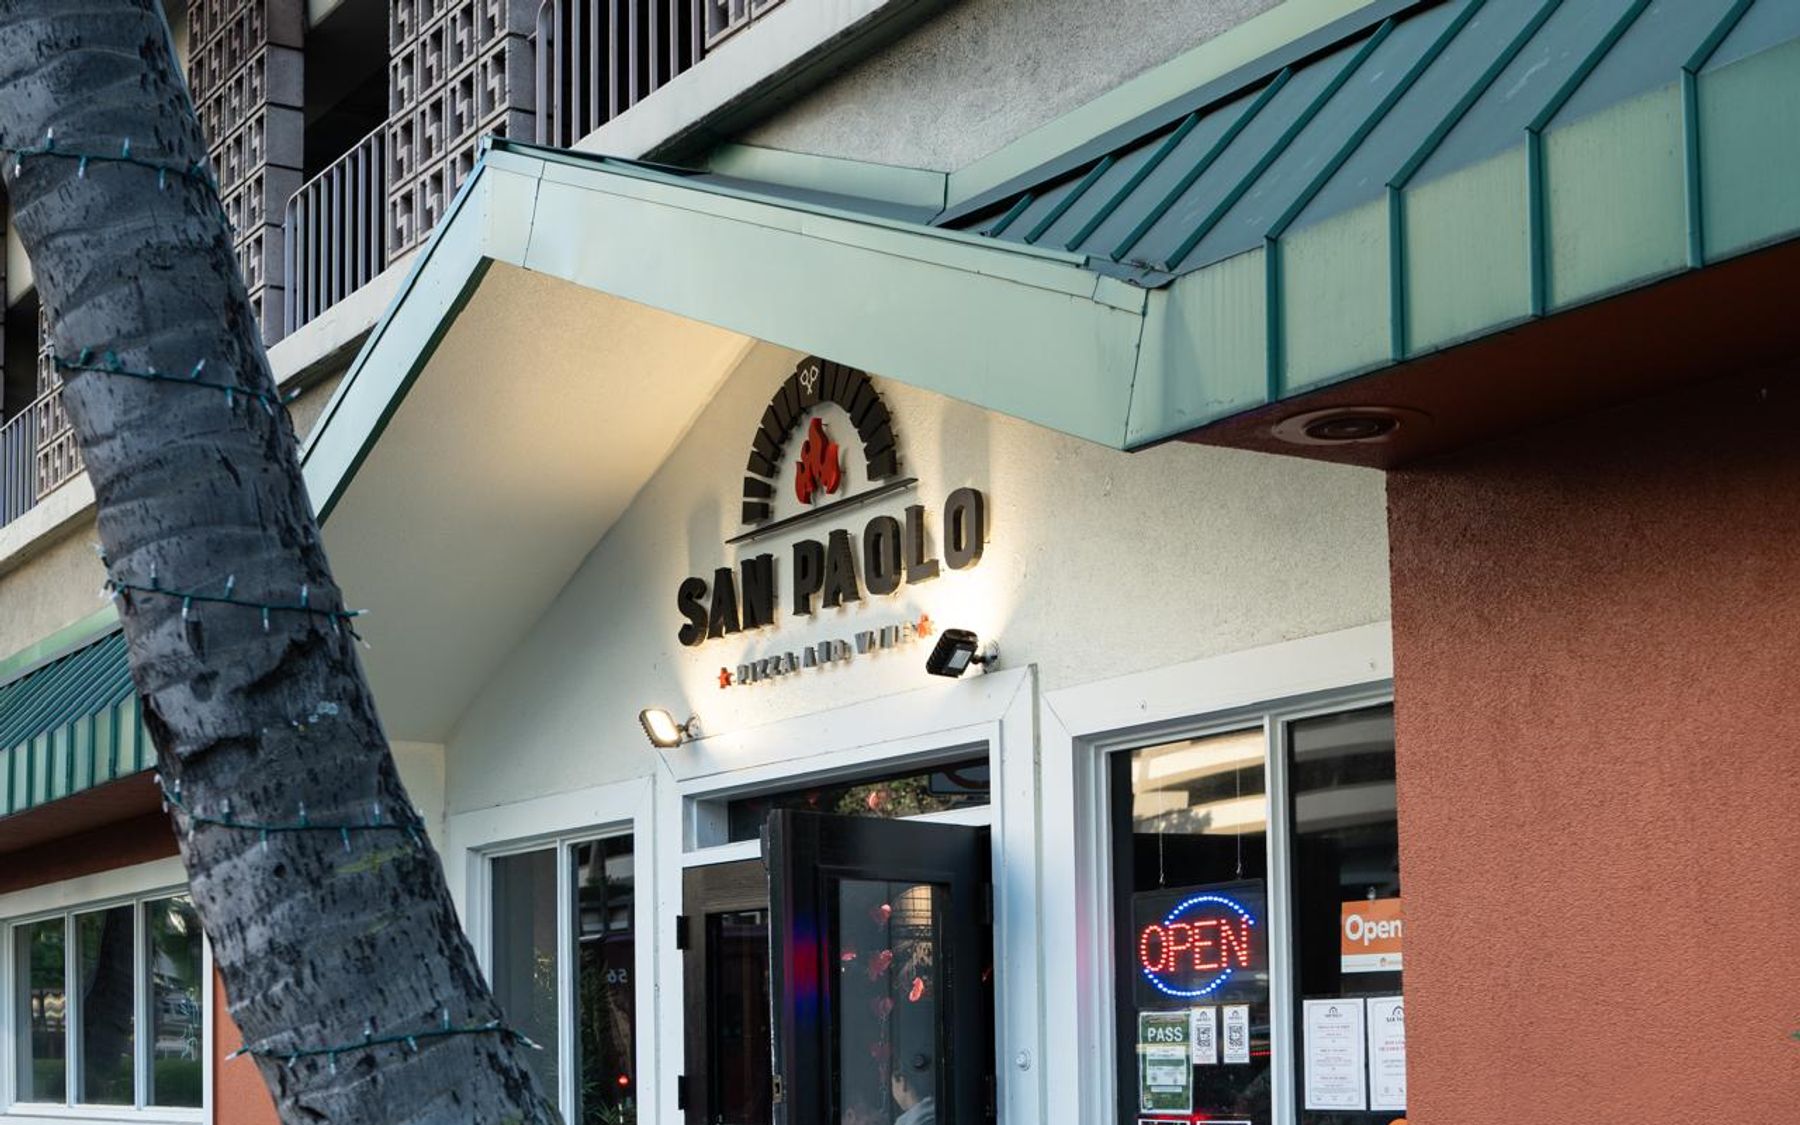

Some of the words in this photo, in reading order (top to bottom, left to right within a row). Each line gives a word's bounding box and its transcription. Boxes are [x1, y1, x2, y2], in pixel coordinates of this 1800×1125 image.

[677, 553, 775, 647] SAN
[792, 486, 986, 616] PAOLO
[736, 651, 799, 685] PIZZA
[803, 638, 852, 668] AND
[1140, 915, 1249, 973] OPEN
[1345, 913, 1402, 946] Open
[1147, 1026, 1184, 1042] PASS
